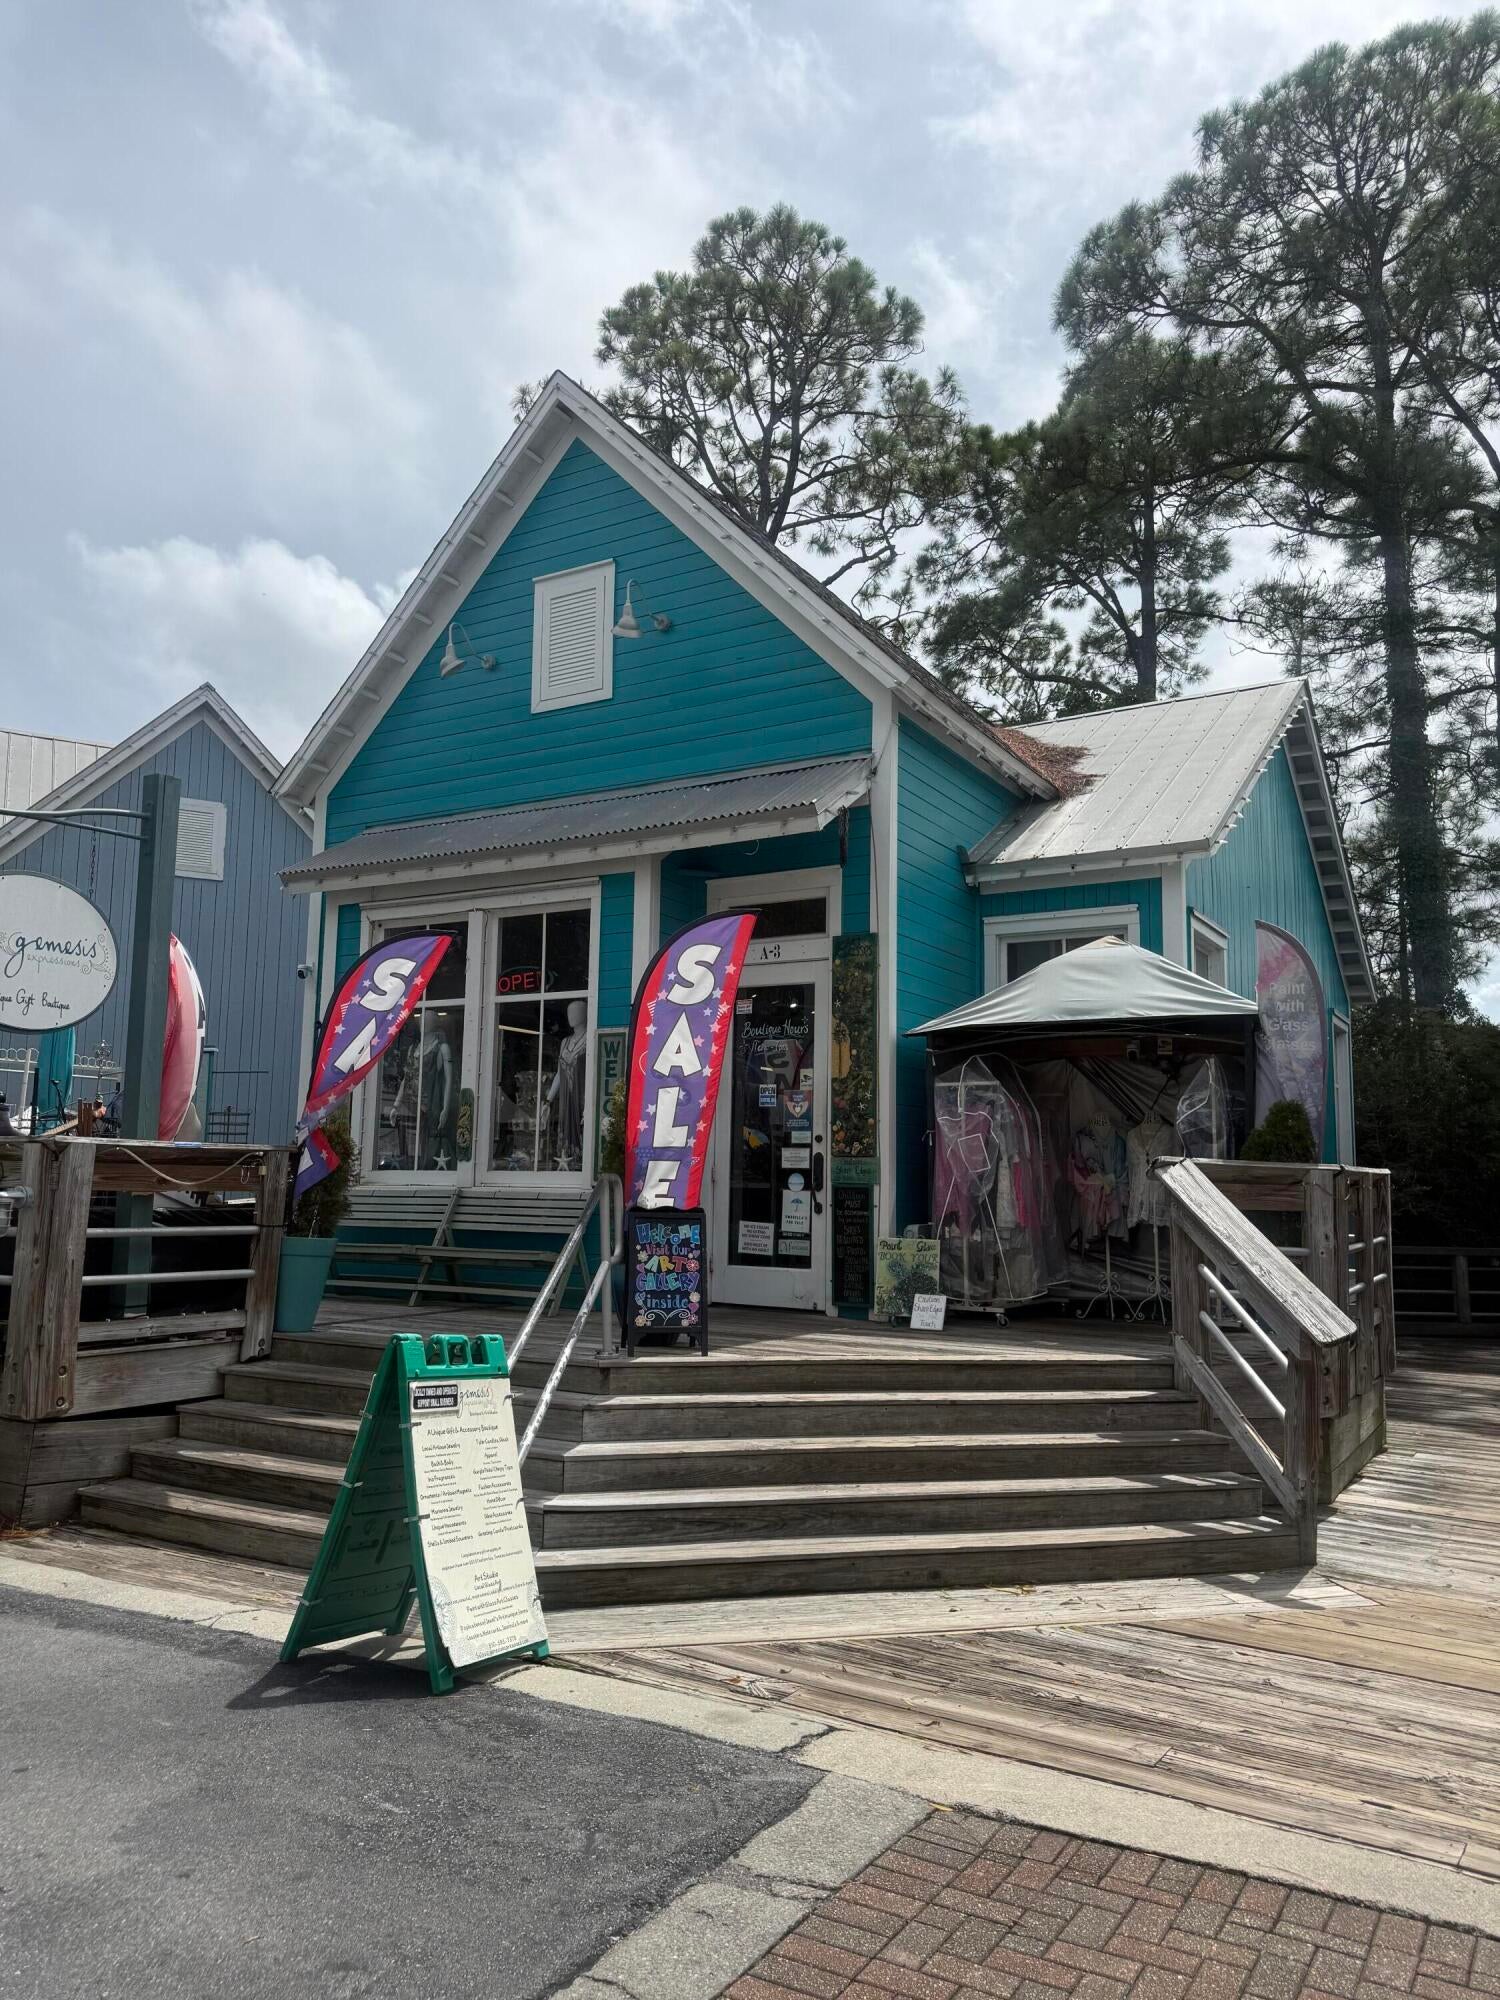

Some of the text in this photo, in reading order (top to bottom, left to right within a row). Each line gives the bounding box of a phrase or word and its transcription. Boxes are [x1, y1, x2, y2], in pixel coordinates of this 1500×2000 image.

[0, 988, 71, 1018] que Gift Boutique
[637, 944, 723, 1208] SALE
[761, 1087, 775, 1095] OPEN
[645, 1244, 689, 1255] Visit Our
[644, 1255, 688, 1273] ART
[636, 1272, 701, 1292] GALLERY
[646, 1294, 689, 1308] inside
